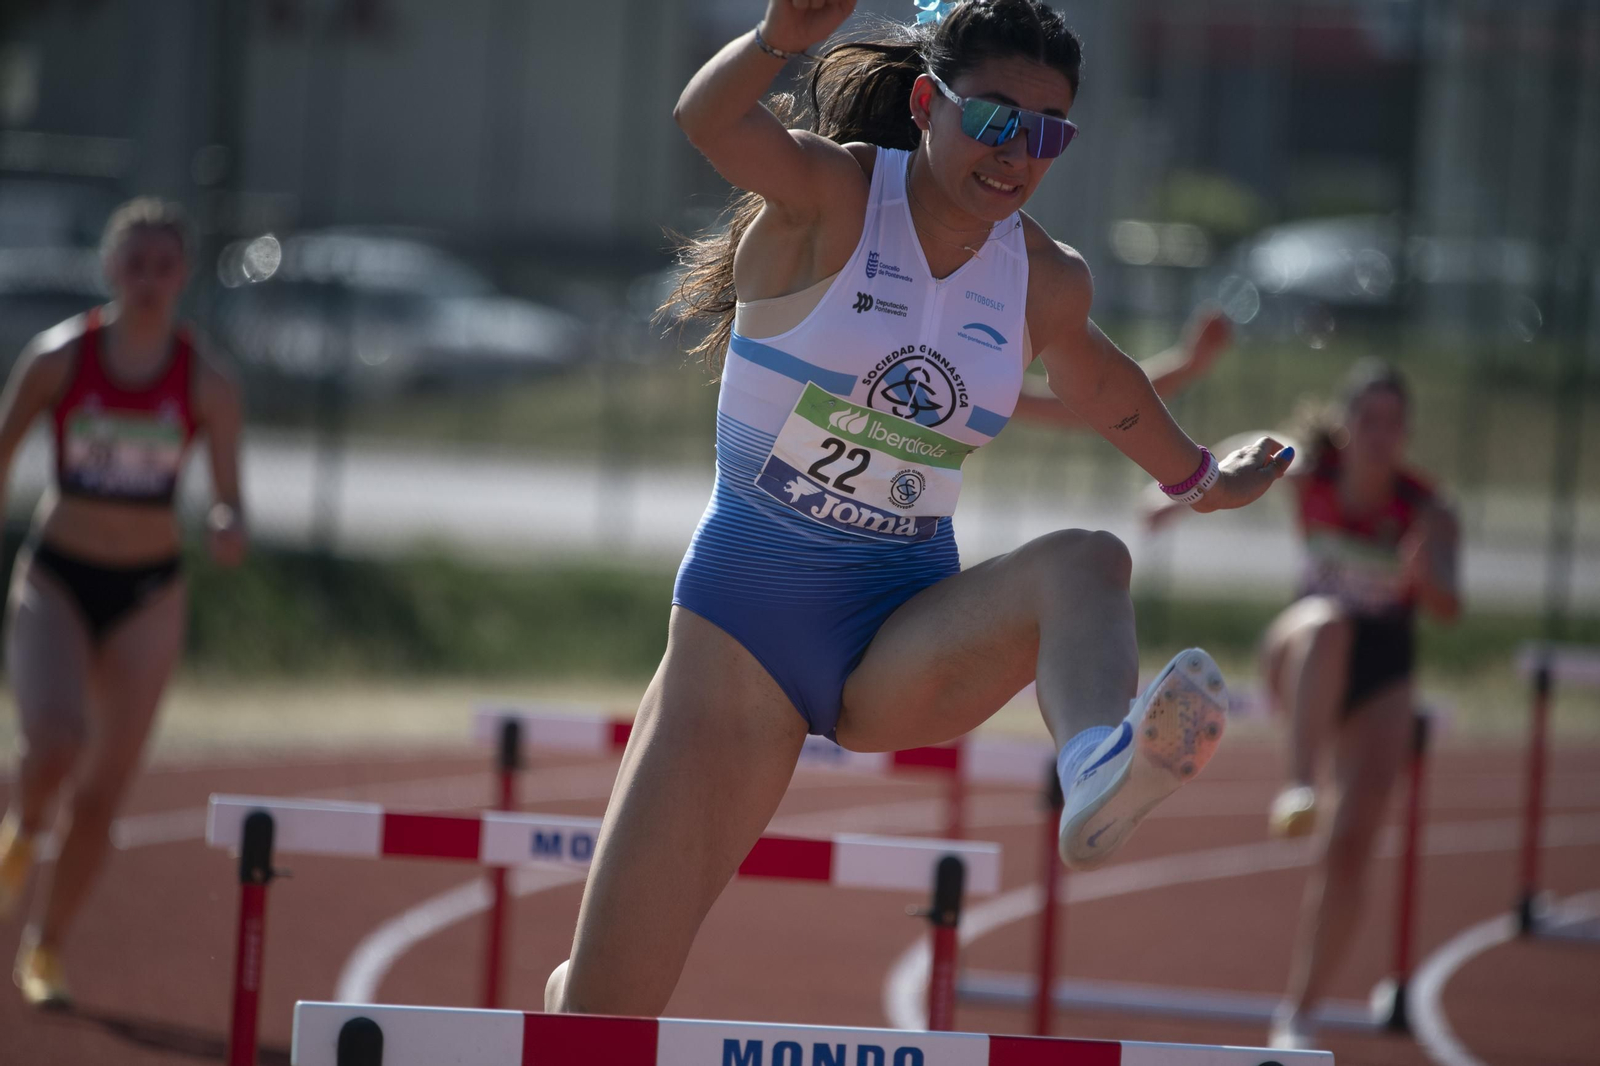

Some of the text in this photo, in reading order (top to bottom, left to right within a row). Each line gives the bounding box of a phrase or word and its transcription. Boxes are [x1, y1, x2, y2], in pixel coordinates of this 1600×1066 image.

[879, 262, 900, 272] Concello
[885, 270, 913, 282] Pontevedra
[875, 305, 907, 317] Pontevedra
[876, 298, 908, 311] Deputación
[965, 290, 1005, 311] OTTOBOSLEY
[862, 344, 969, 408] SOCIEDAD GIMNÁSTICA
[868, 420, 947, 458] Iberdrola
[807, 437, 871, 494] 22
[810, 493, 918, 537] Joma
[722, 1038, 925, 1066] MONDO
